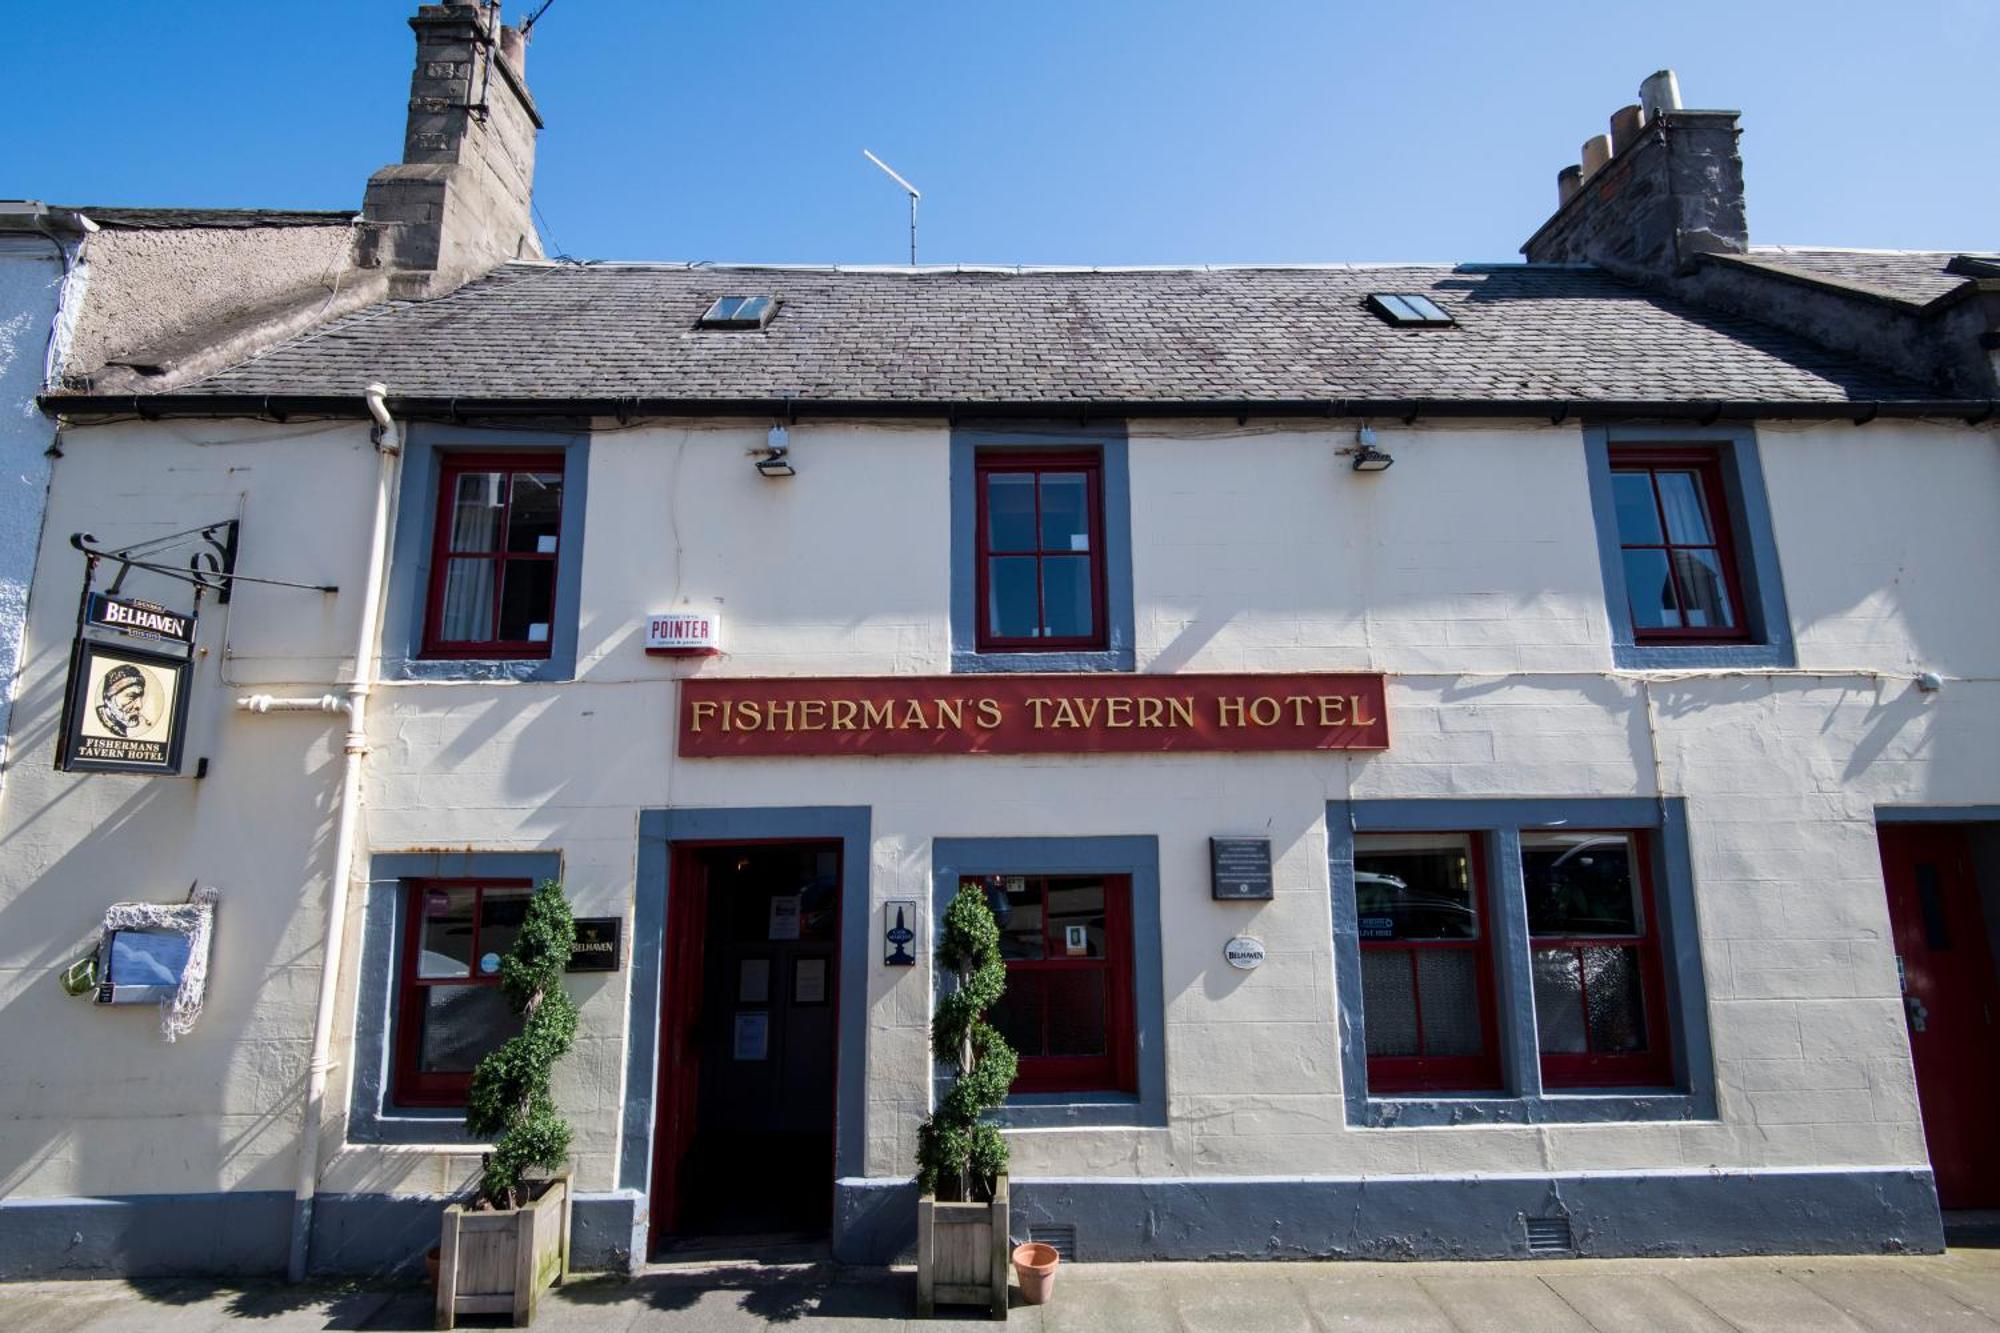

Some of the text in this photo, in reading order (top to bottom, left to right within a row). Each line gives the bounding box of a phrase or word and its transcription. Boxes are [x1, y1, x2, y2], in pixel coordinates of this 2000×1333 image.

[103, 601, 185, 637] BELHAVEN
[651, 620, 709, 639] POINTER
[690, 695, 1377, 732] FISHERMAN'S TAVERN HOTEL
[78, 737, 164, 762] FISHERMANS TAVERN HOTEL
[1228, 951, 1264, 960] BELHAVEN
